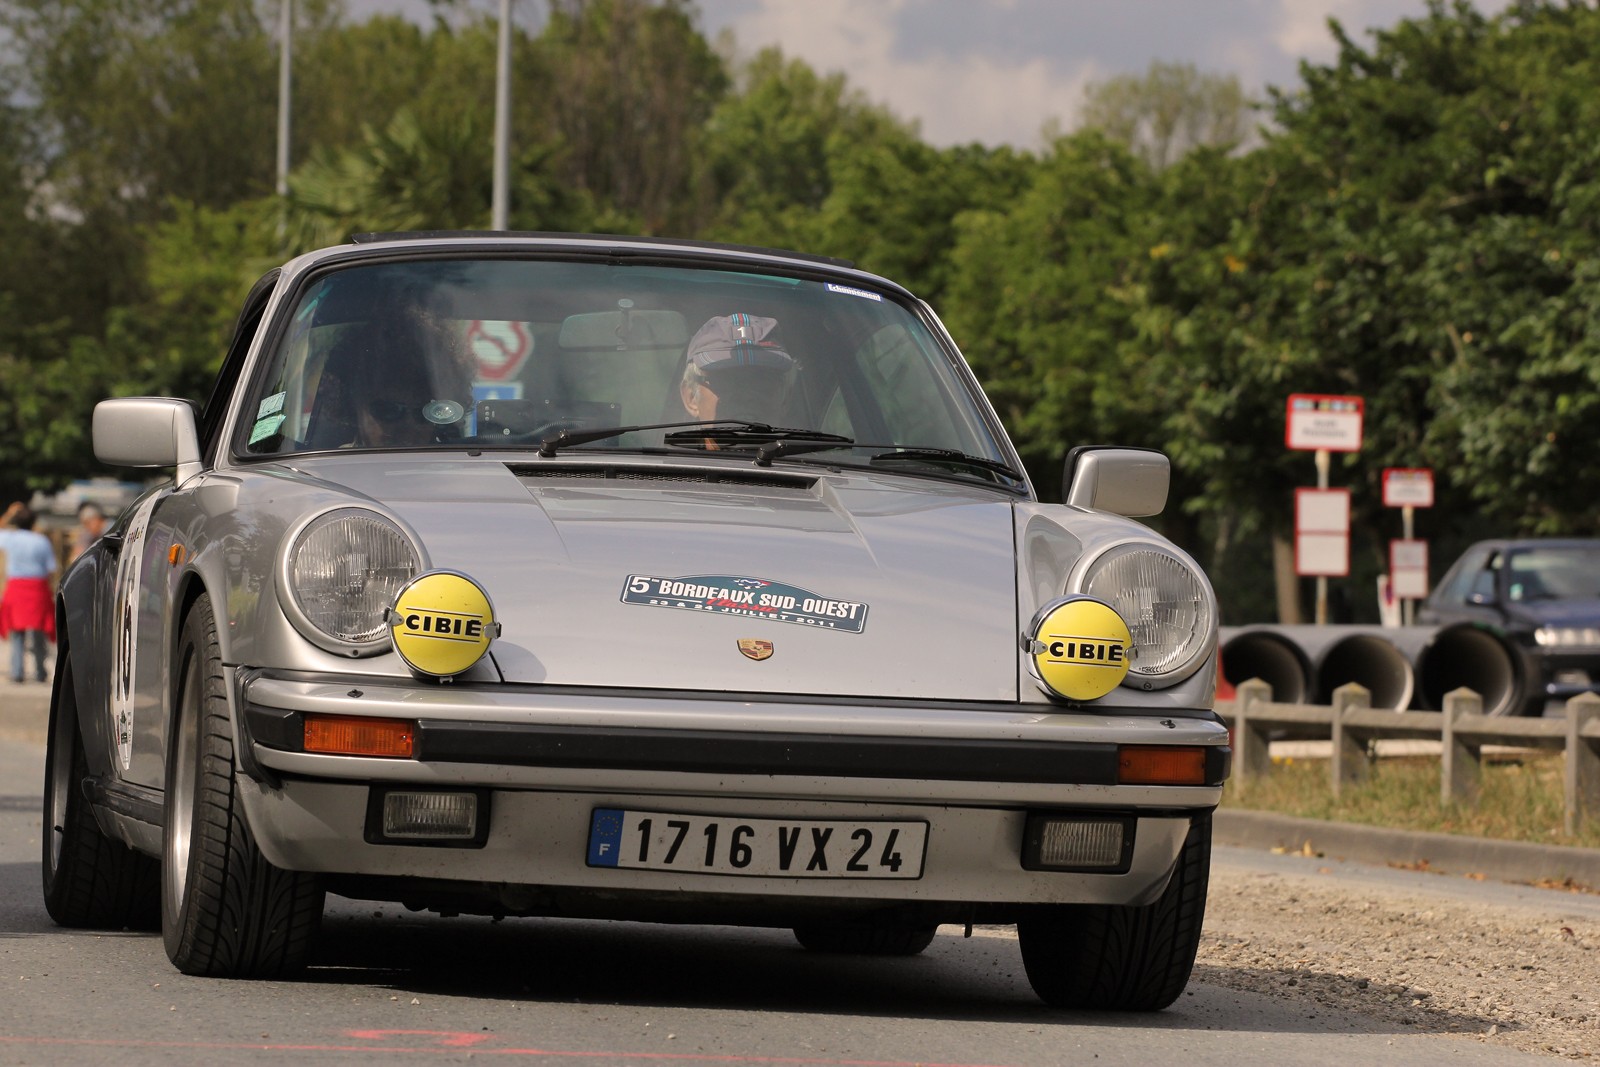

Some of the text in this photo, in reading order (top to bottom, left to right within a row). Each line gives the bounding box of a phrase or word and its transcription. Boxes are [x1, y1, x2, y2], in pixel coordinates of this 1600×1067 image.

[737, 326, 745, 338] 1
[658, 580, 756, 605] BORDEAUX
[759, 593, 861, 620] SUD-OUEST
[721, 607, 789, 620] JUILLET
[796, 617, 835, 628] 2011
[599, 843, 610, 856] F
[637, 818, 902, 872] 1716 VX 24
